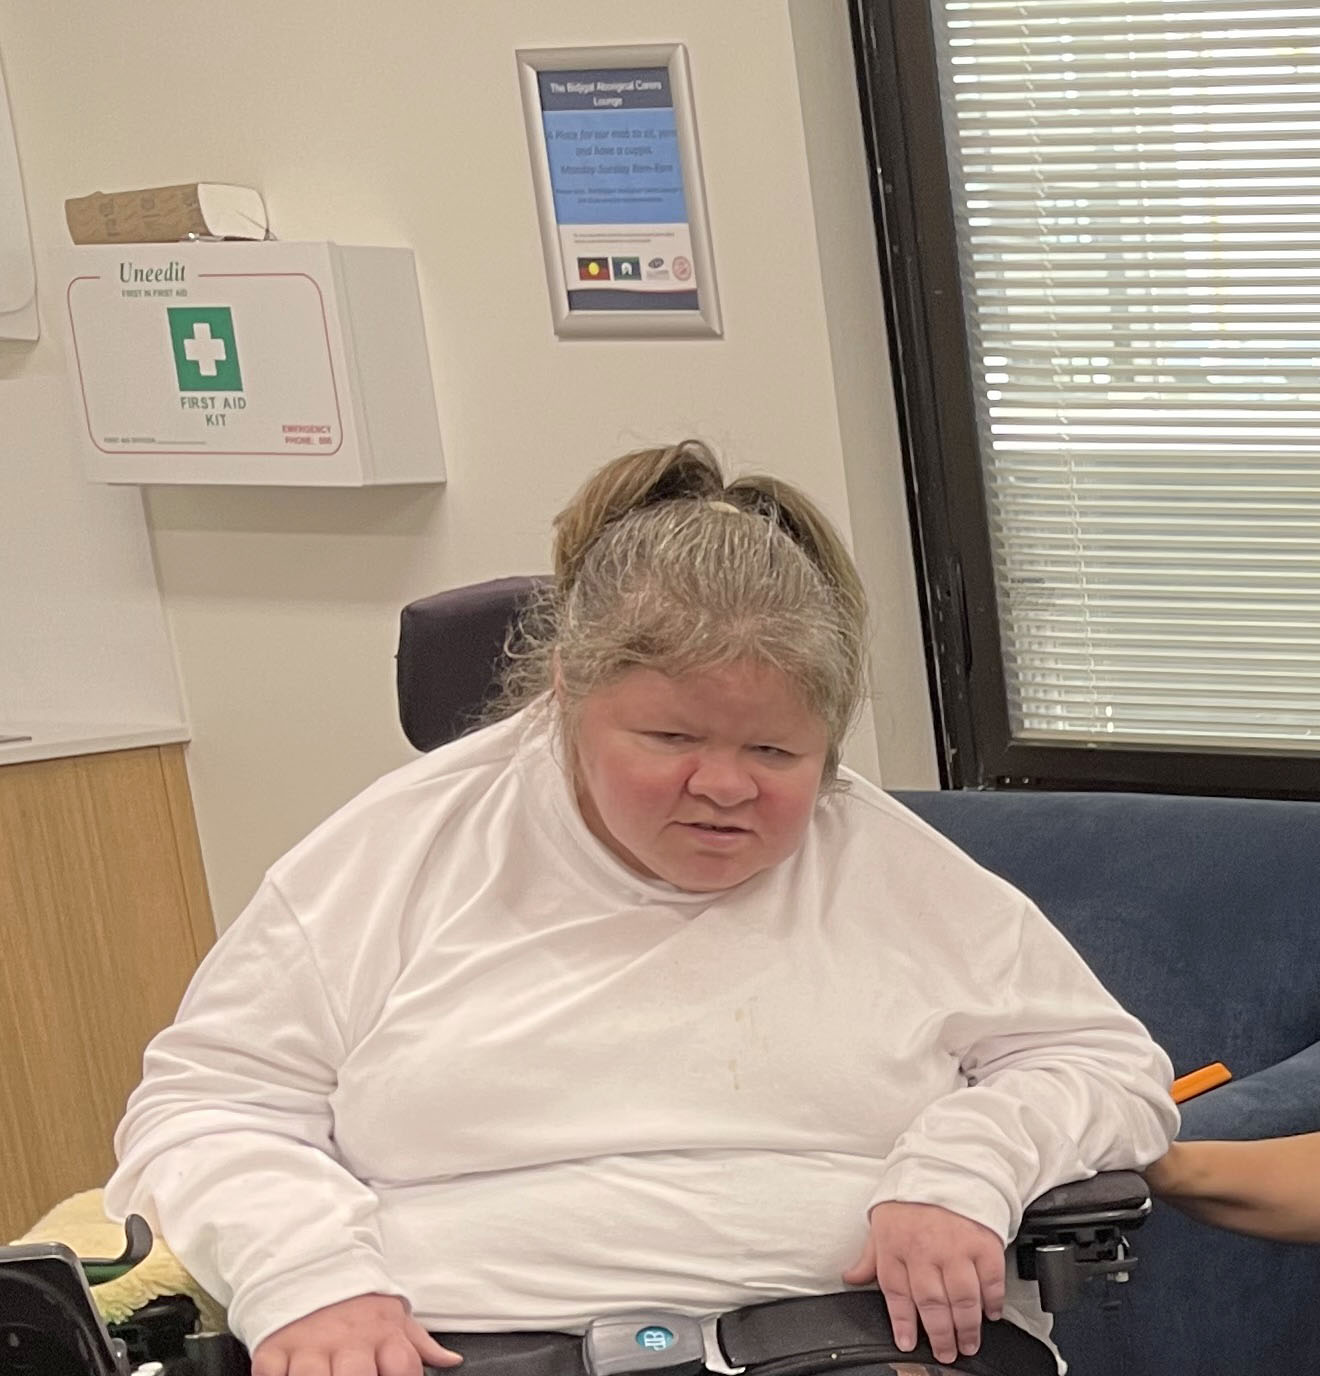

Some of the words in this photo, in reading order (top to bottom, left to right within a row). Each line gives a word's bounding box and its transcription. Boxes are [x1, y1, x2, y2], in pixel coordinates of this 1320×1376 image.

[550, 82, 566, 93] The
[593, 96, 623, 107] Lounge
[120, 261, 185, 283] Uneedit
[180, 396, 215, 410] FIRST
[223, 397, 247, 410] AID
[205, 414, 227, 426] KIT
